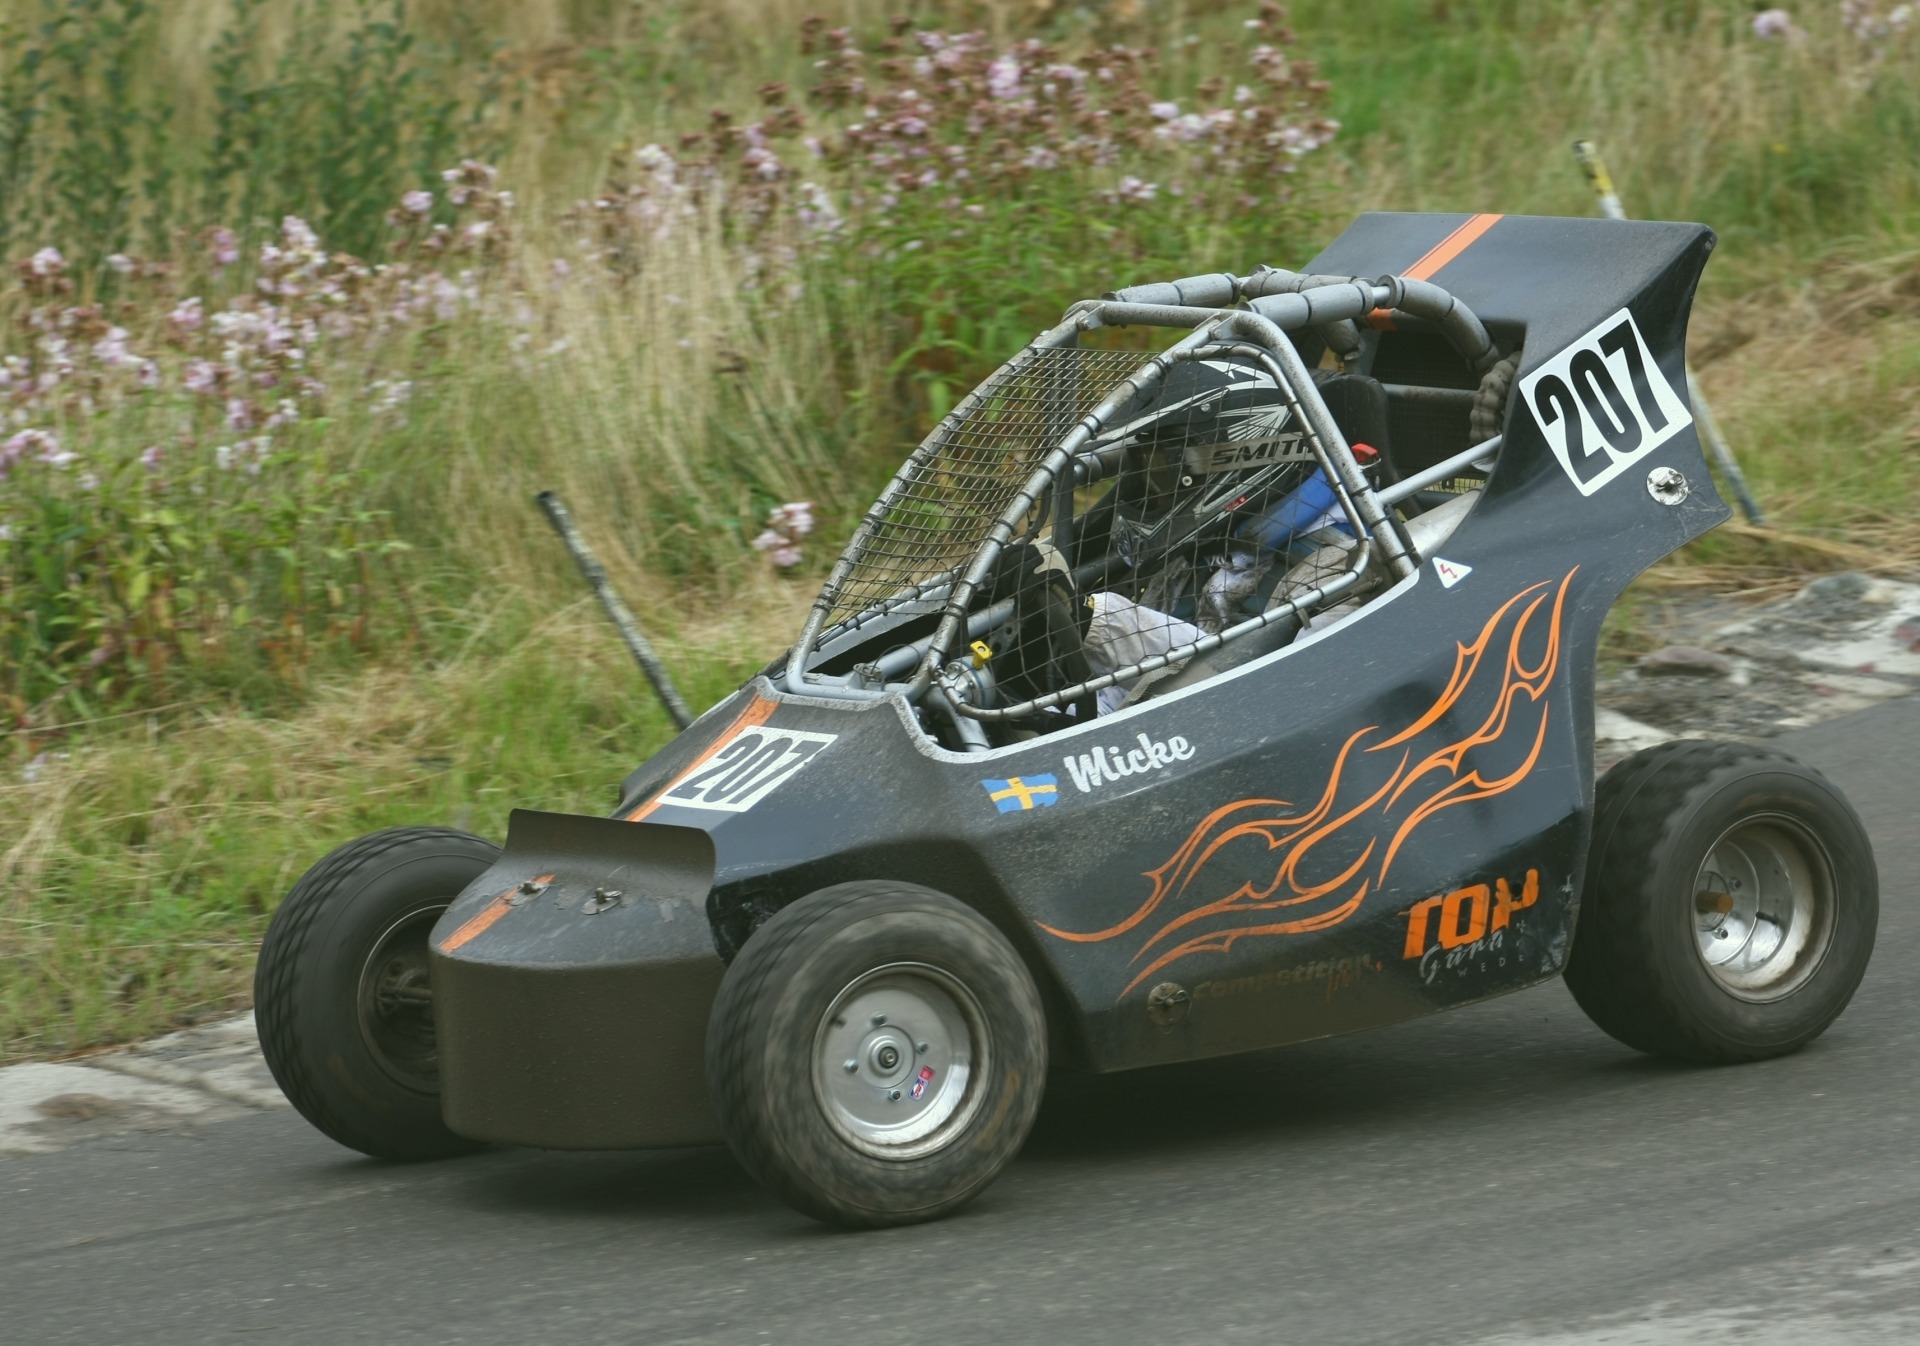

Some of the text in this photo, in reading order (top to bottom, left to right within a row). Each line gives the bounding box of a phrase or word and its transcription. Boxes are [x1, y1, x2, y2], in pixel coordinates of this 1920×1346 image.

[1534, 318, 1670, 486] 207
[1211, 438, 1314, 466] SMITH
[666, 733, 829, 804] 207
[1063, 733, 1196, 793] Micke
